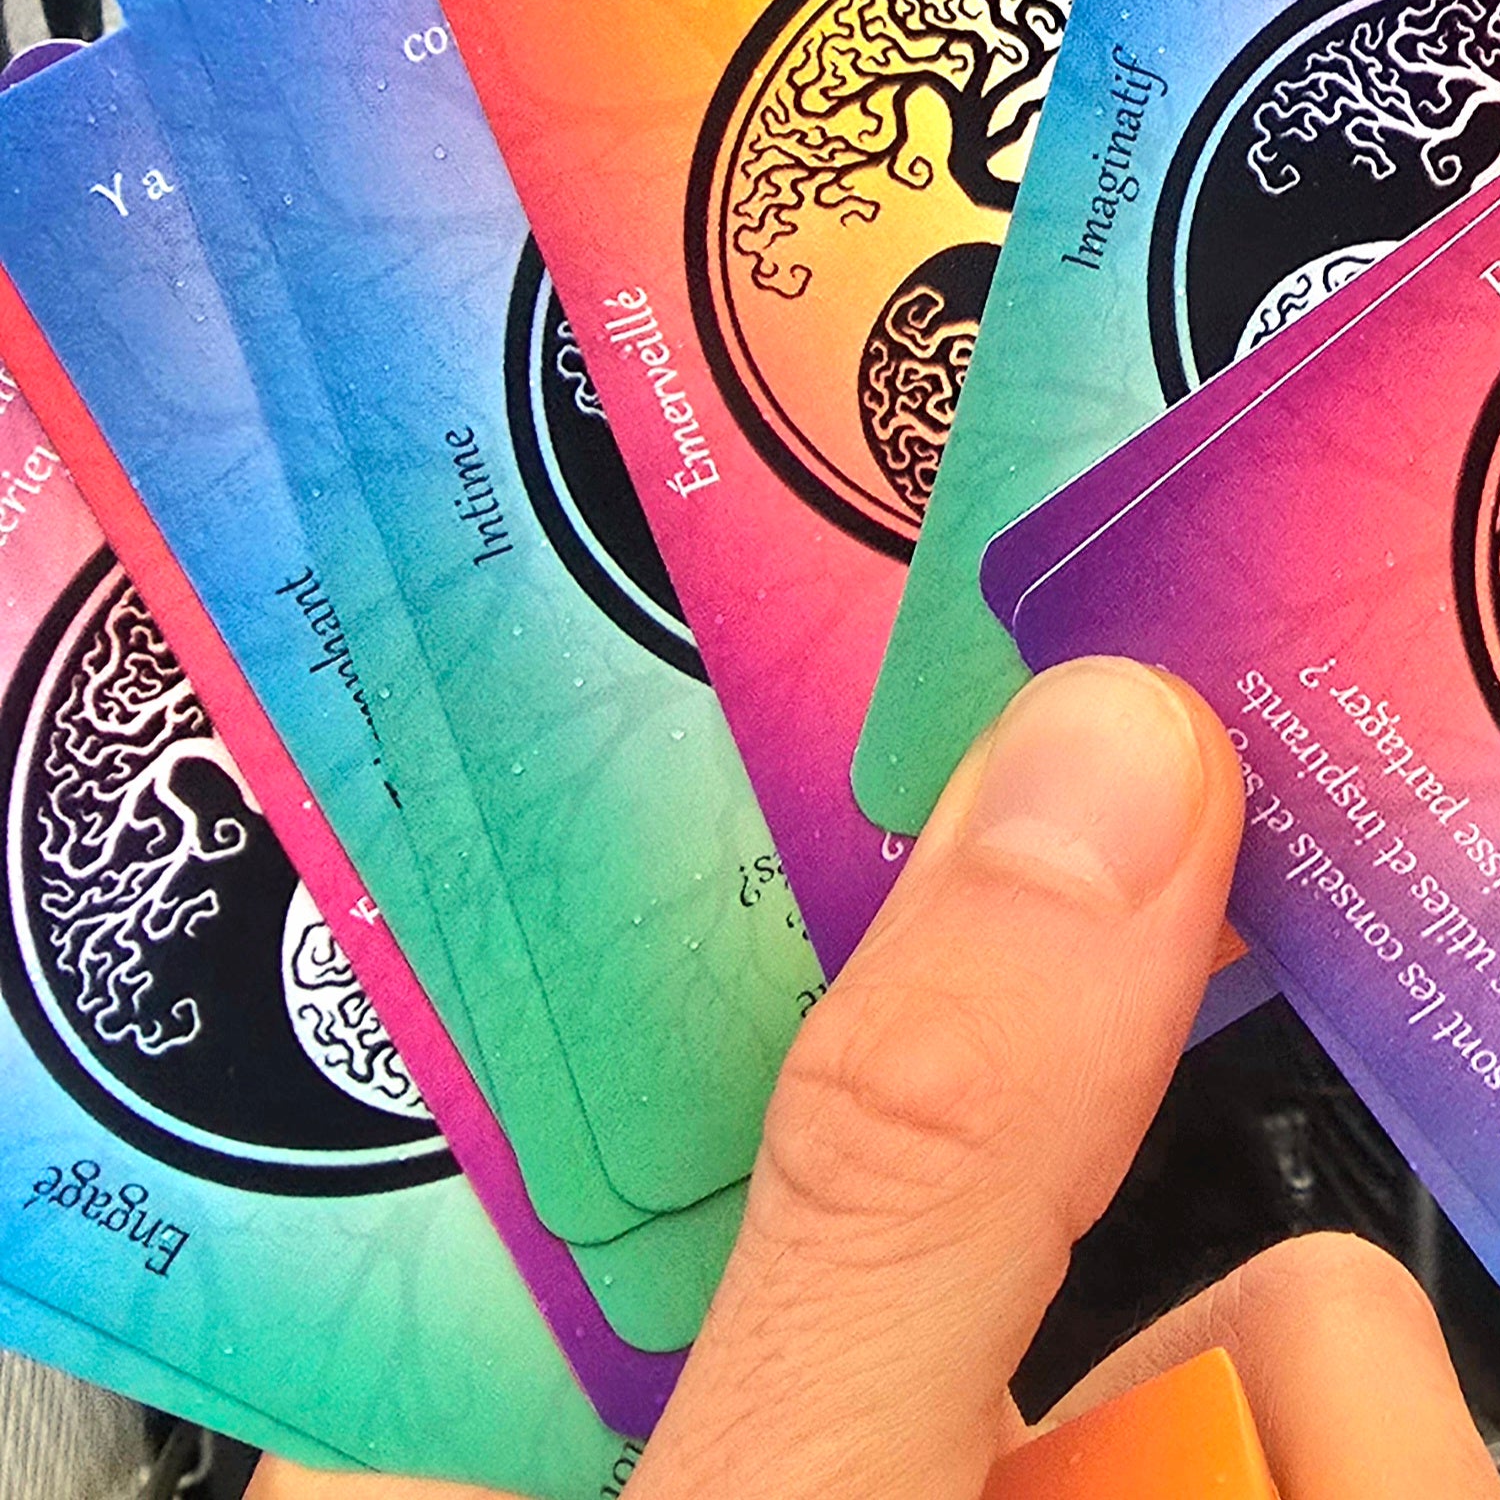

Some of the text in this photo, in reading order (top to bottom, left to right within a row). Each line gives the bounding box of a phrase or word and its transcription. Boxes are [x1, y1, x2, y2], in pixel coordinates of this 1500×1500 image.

[404, 26, 449, 62] co
[1061, 43, 1168, 270] Imaginatif
[603, 286, 720, 498] Émerveillé
[445, 424, 514, 567] Intime
[1297, 657, 1338, 690] ?
[1236, 669, 1387, 847] inspirants
[1250, 793, 1295, 834] et
[1328, 684, 1471, 828] partager
[1284, 832, 1405, 963] conseils
[1372, 835, 1418, 876] et
[1409, 873, 1497, 975] utiles
[1397, 961, 1447, 1026] les
[22, 1159, 190, 1278] Engagé
